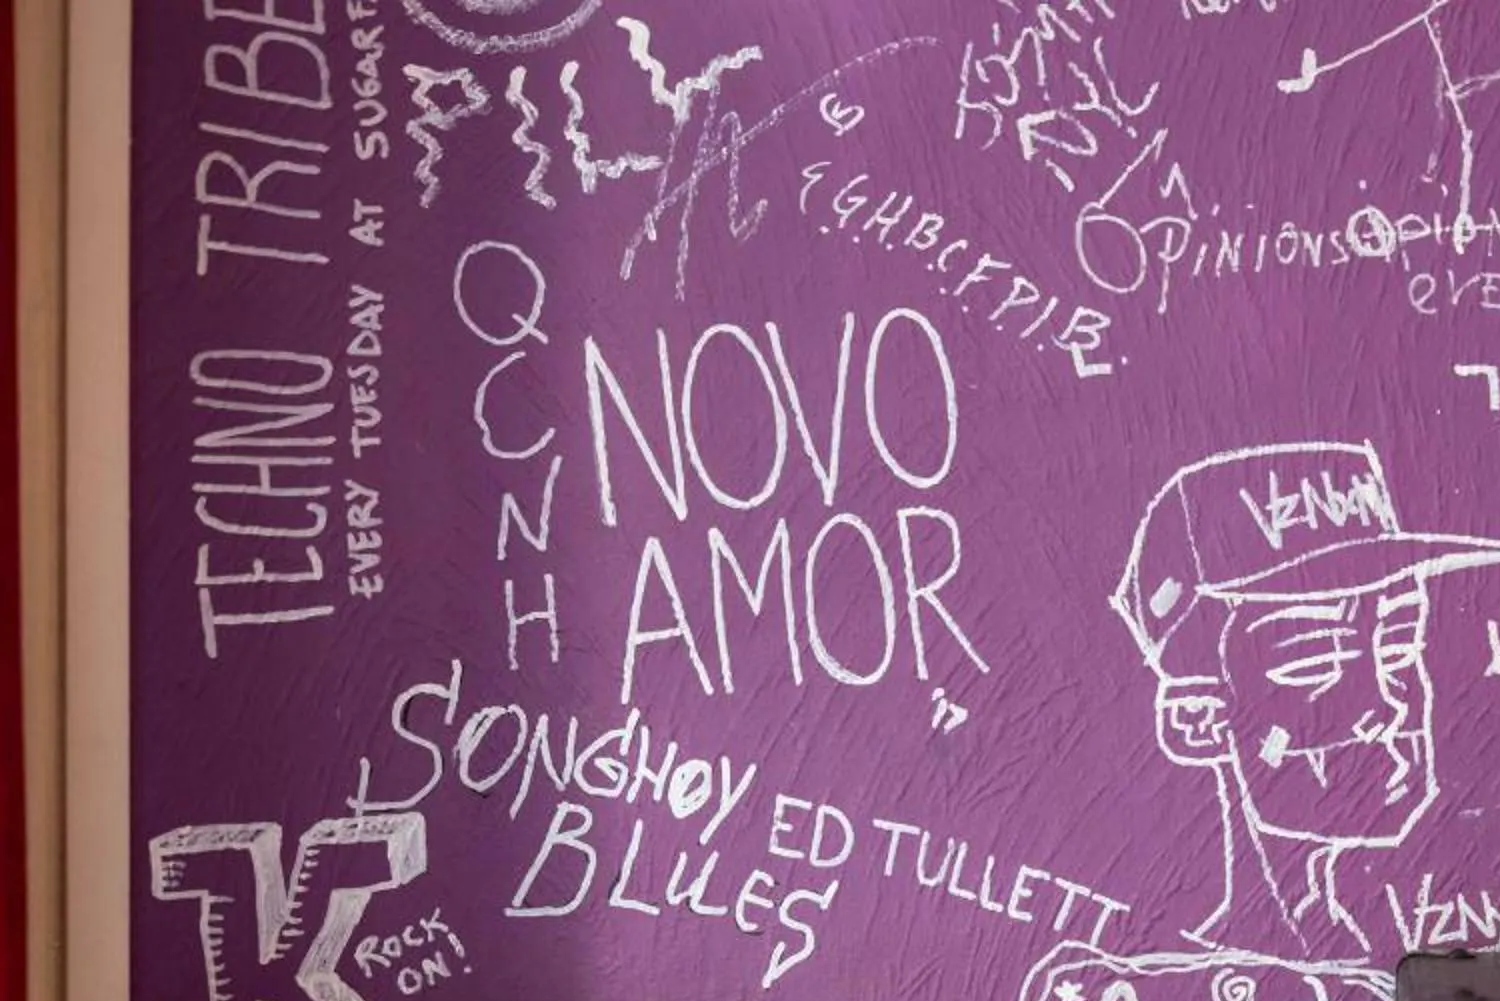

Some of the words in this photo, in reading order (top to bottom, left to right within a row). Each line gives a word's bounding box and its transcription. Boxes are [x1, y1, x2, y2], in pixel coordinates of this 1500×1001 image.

[349, 200, 385, 246] AT
[347, 285, 385, 457] TUESDAY
[584, 308, 958, 526] NOVO
[190, 350, 336, 658] TECHNO
[346, 480, 385, 598] EVERY
[620, 506, 990, 704] AMOR
[354, 907, 449, 979] ROCK
[504, 802, 838, 989] BLUES
[768, 794, 856, 868] ED
[873, 819, 1130, 947] TULLETT
